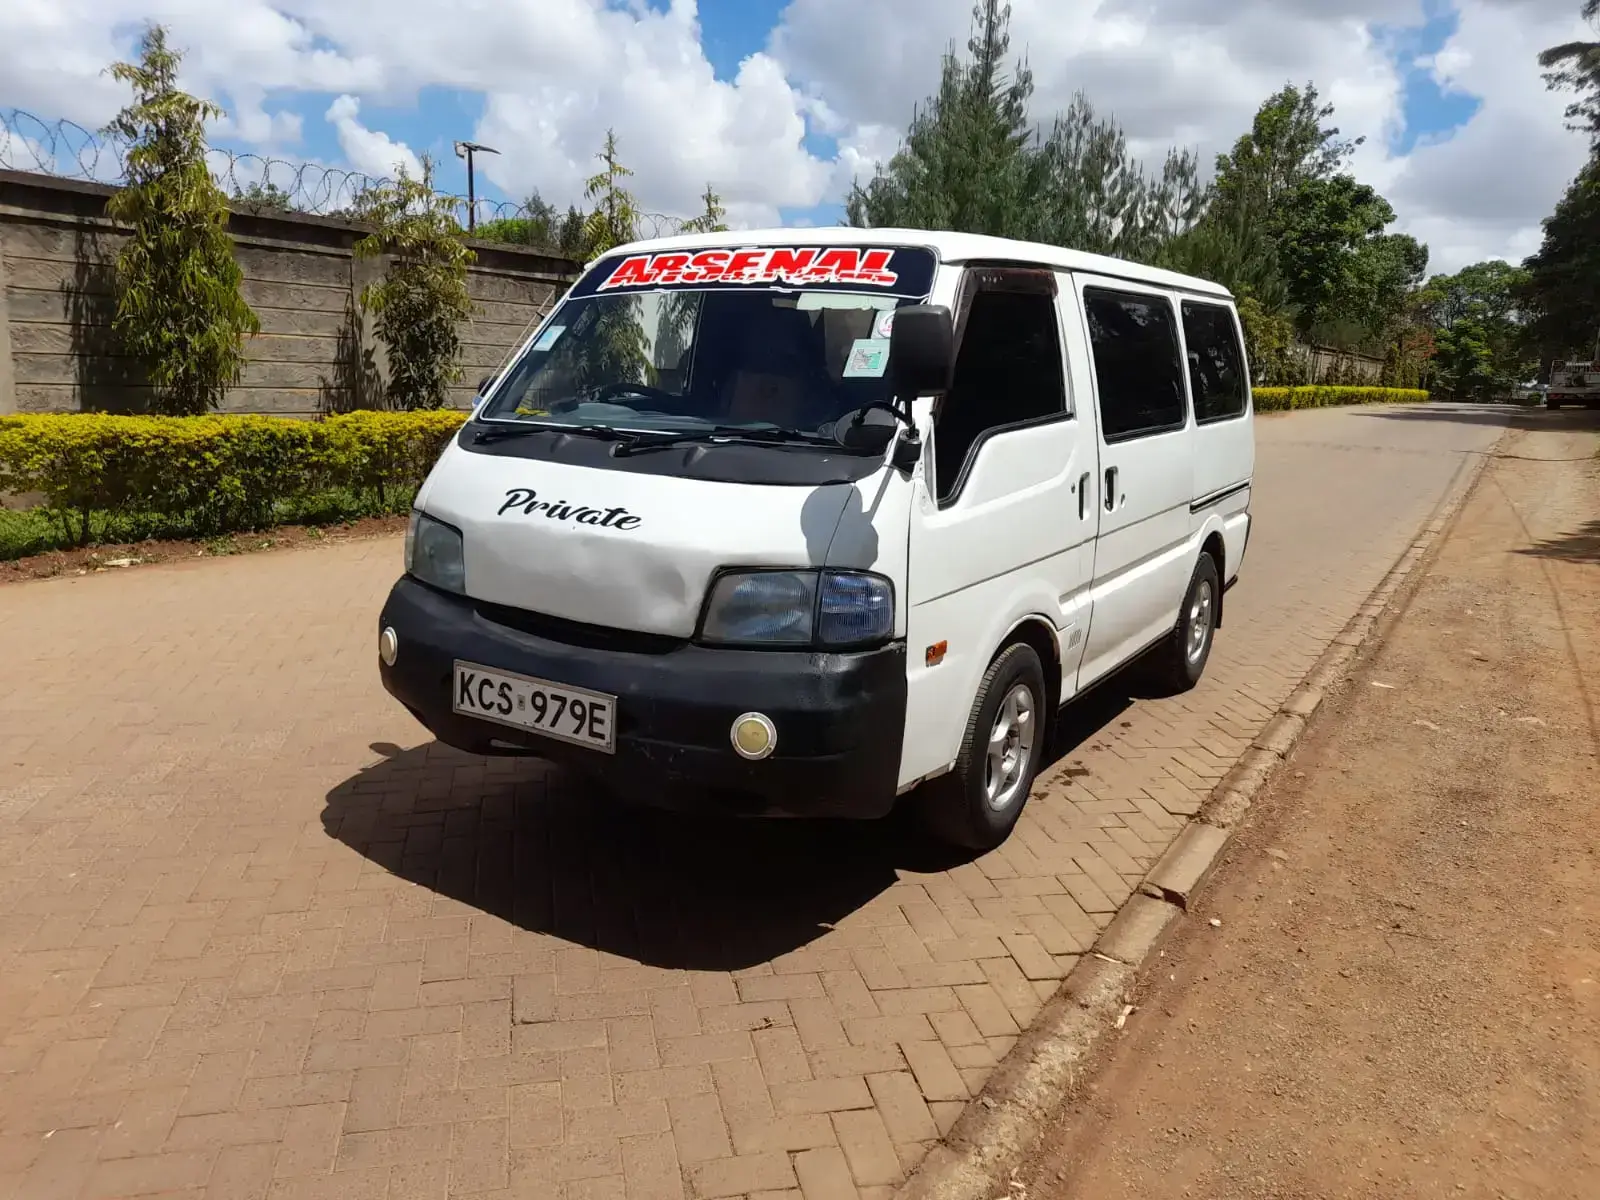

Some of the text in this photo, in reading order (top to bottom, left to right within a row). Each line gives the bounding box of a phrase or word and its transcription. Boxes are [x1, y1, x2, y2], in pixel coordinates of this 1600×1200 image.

[597, 248, 898, 292] ARSENAL
[497, 488, 642, 531] Private
[460, 671, 607, 741] KCS 979E
